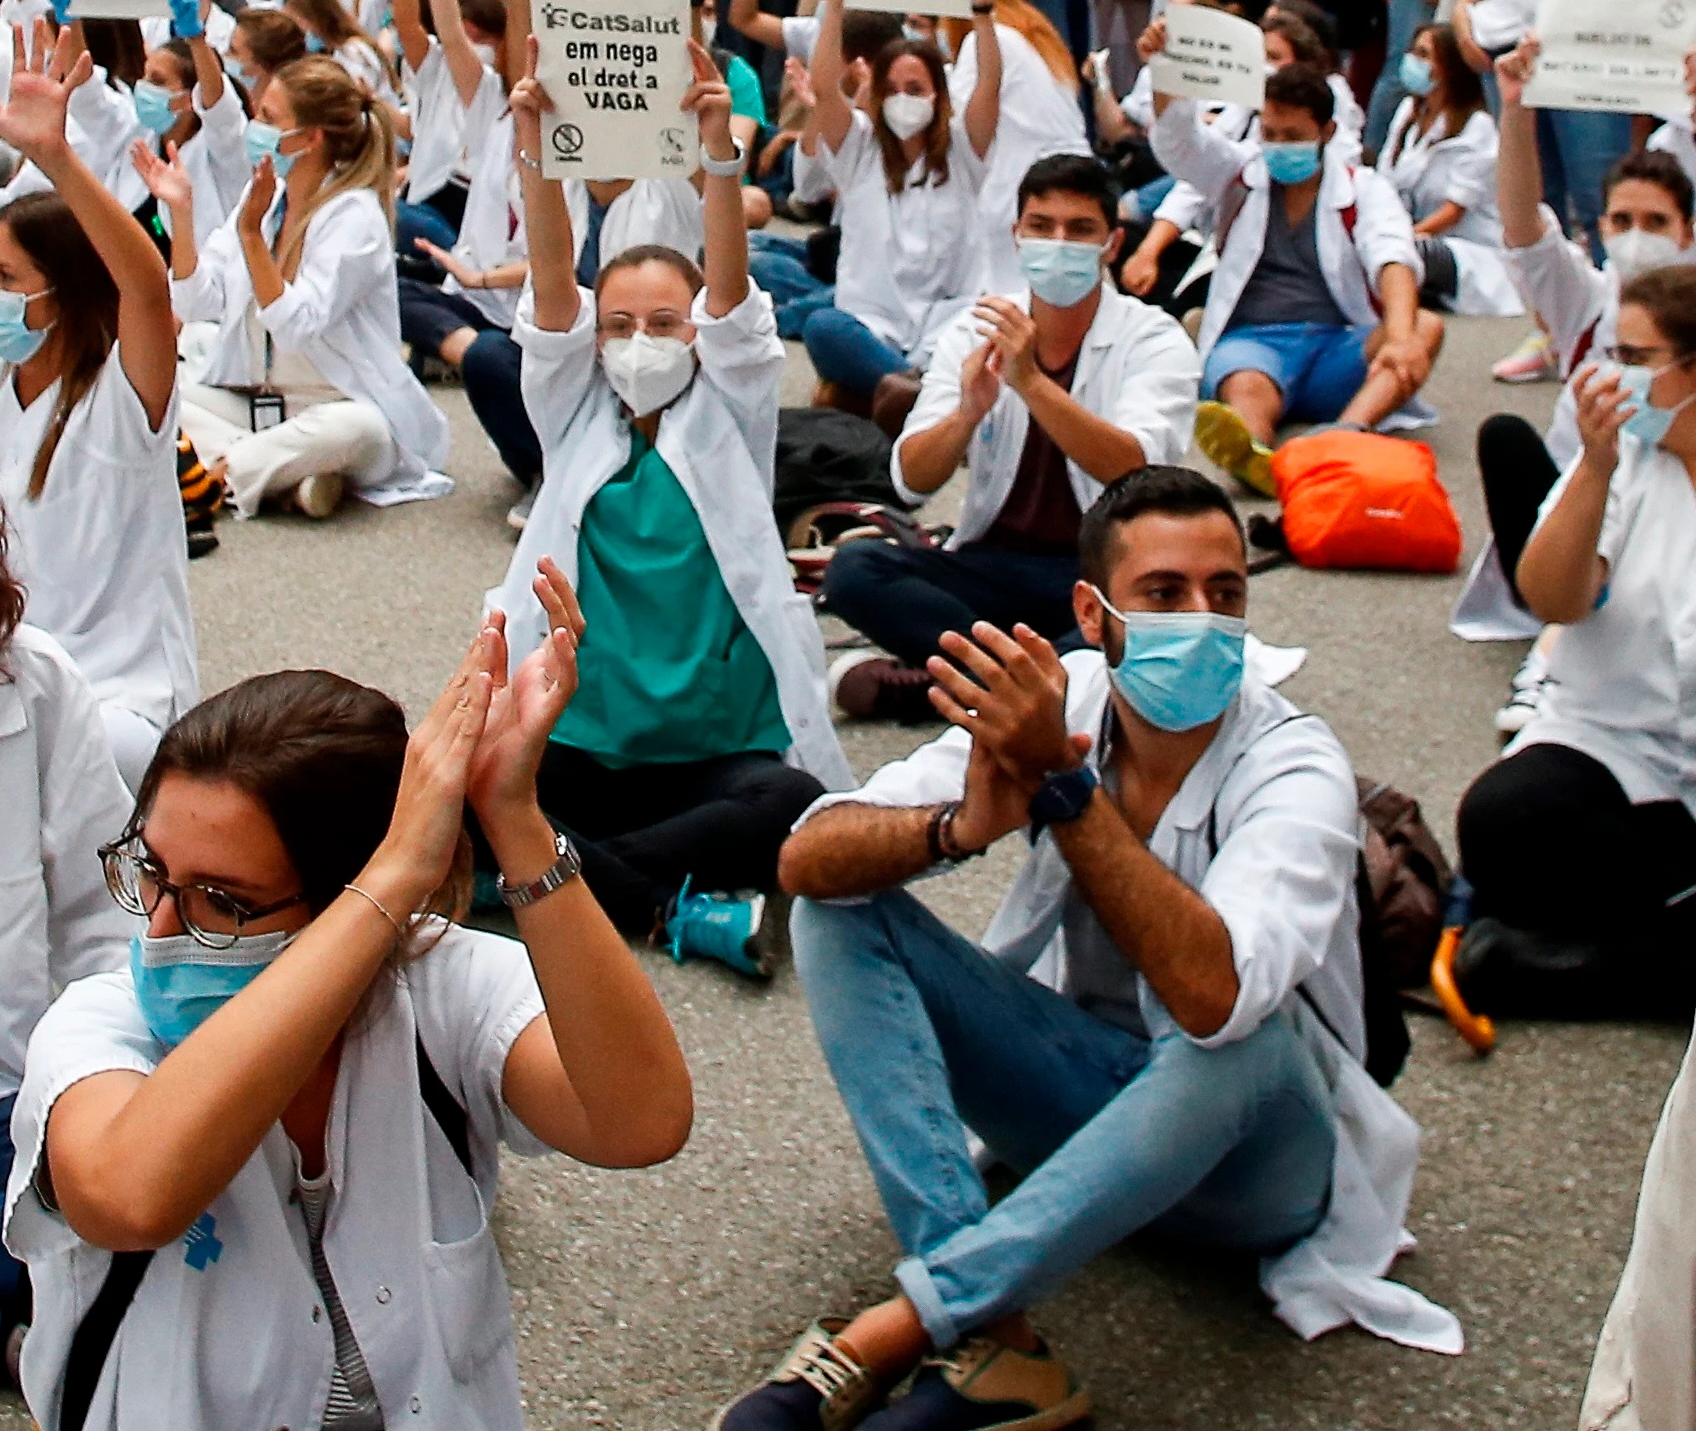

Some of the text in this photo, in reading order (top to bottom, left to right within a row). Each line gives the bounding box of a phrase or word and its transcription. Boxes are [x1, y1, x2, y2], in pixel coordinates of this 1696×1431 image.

[571, 12, 680, 35] CatSalut
[566, 42, 657, 68] em nega
[568, 67, 658, 89] el dret a
[584, 92, 649, 111] VAGA
